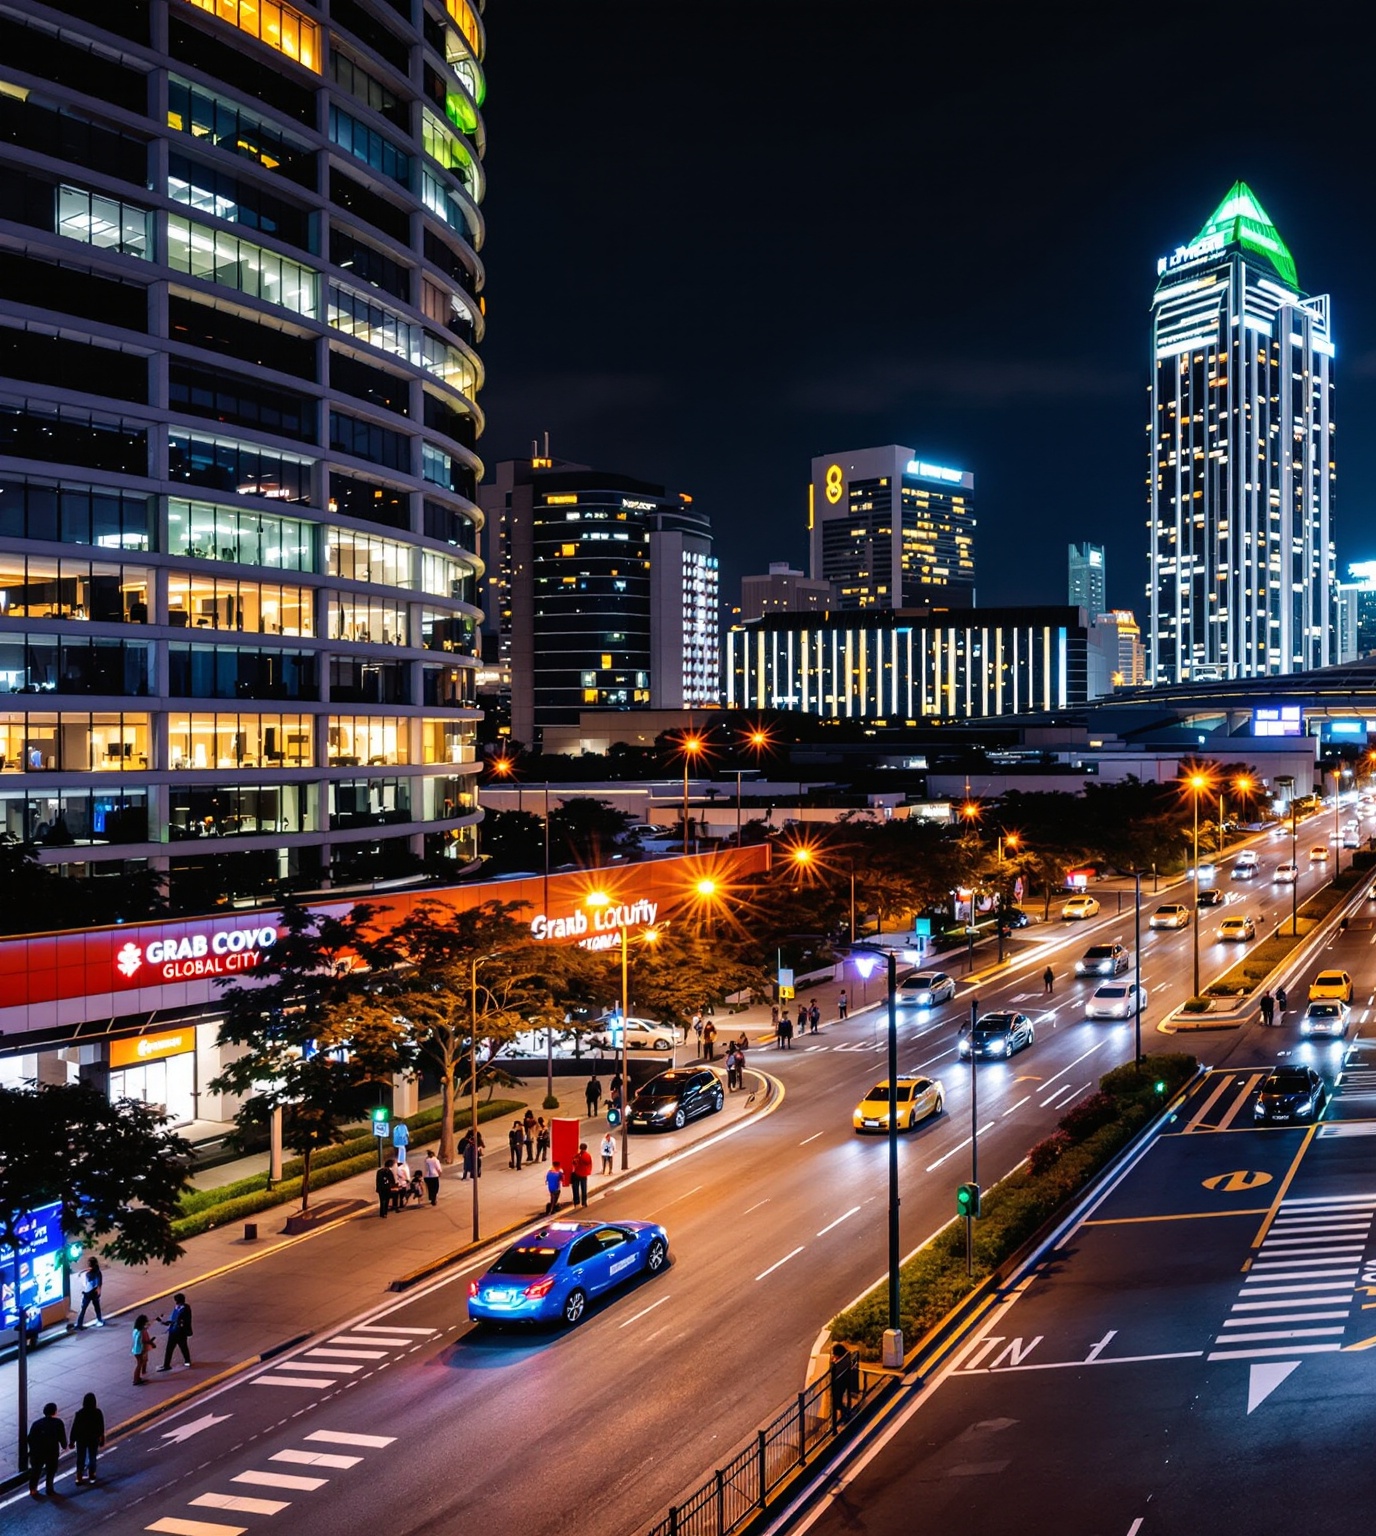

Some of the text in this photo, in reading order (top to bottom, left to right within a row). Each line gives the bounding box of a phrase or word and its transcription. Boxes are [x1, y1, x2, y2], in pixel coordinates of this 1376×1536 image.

[146, 926, 277, 963] GRAB COVO
[163, 951, 260, 978] GLOBAL CITY
